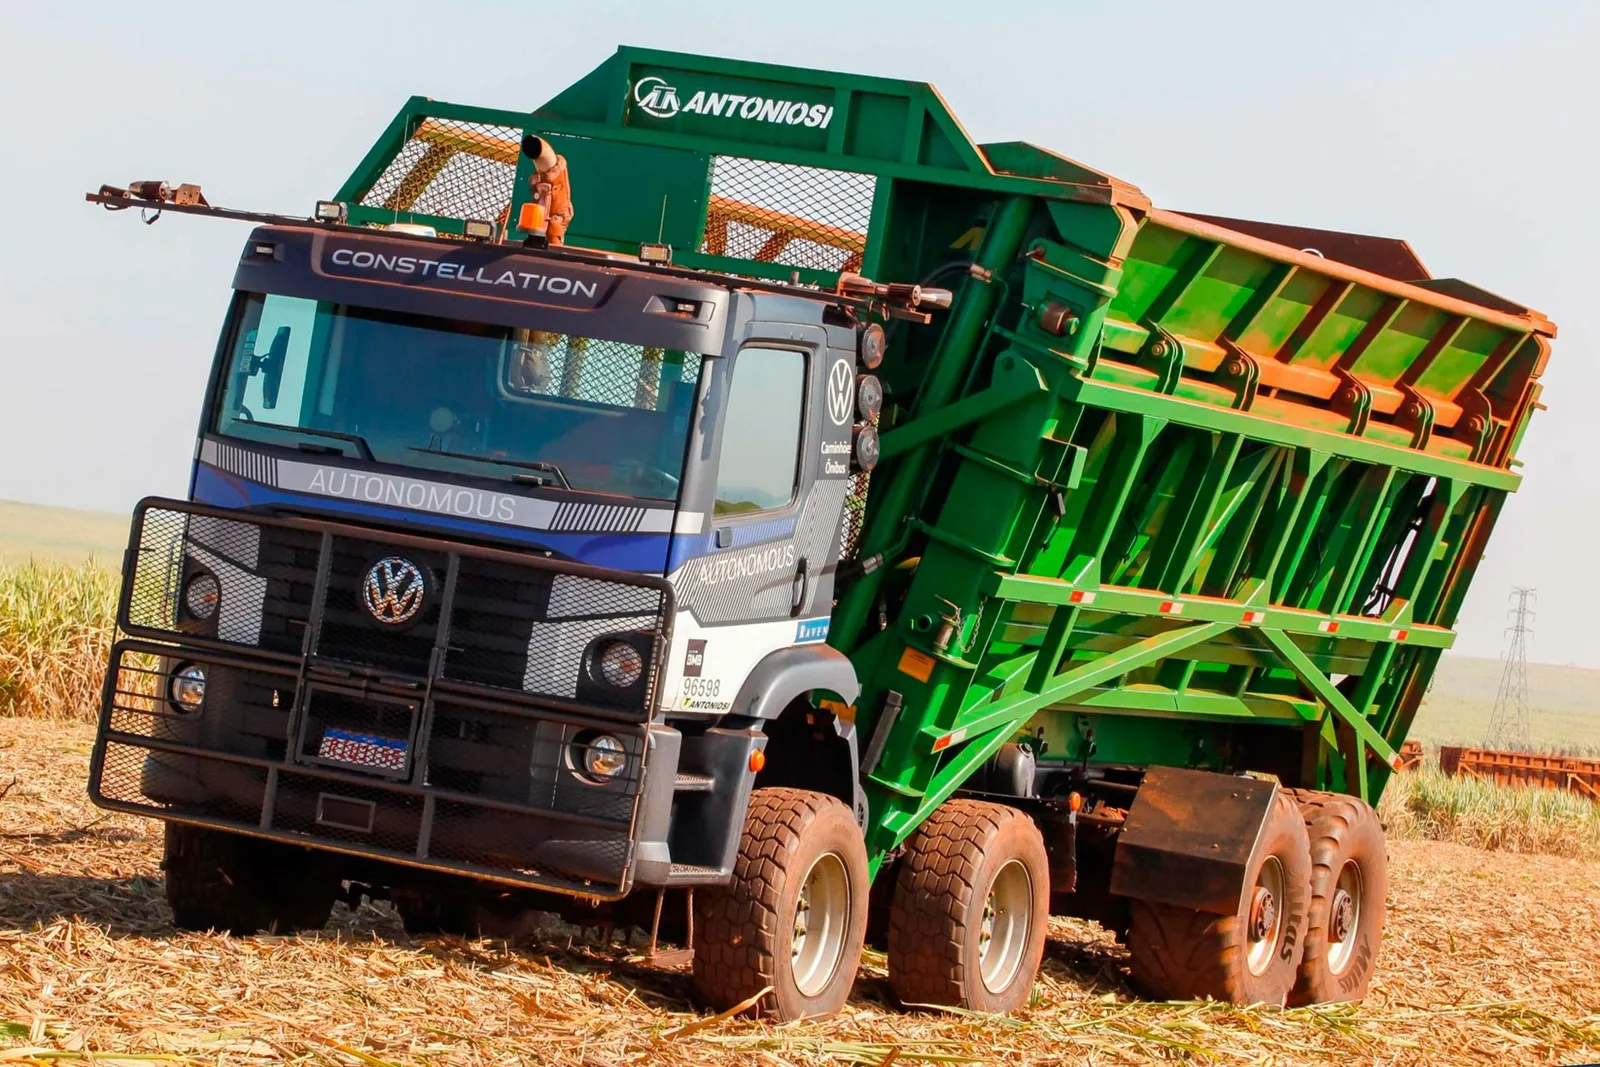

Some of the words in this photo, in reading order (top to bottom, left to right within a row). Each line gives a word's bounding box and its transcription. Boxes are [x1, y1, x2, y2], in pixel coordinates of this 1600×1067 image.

[682, 91, 834, 129] ANTONIOSI
[331, 249, 598, 299] CONSTELLATION
[825, 458, 846, 474] Ônibus
[308, 468, 517, 522] AUTONOMOUS
[700, 545, 794, 585] AUTONOMOUS
[683, 677, 721, 697] 96598
[689, 700, 731, 711] ANTONIOSI
